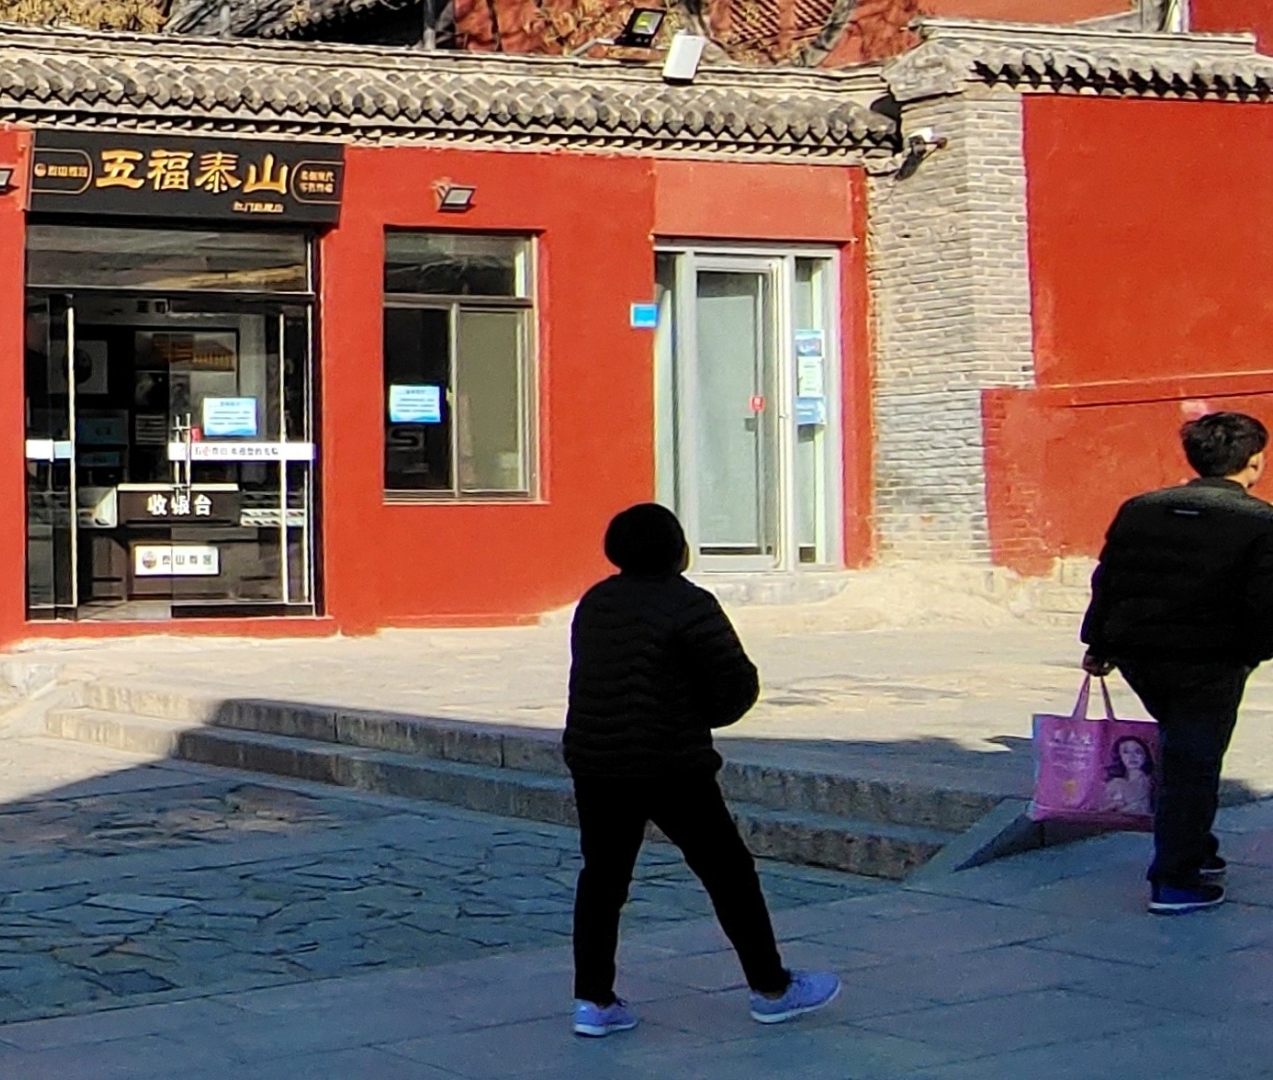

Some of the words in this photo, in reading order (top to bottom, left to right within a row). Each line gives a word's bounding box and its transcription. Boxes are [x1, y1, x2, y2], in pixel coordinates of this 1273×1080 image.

[96, 150, 289, 194] 五福泰山
[147, 494, 213, 516] 收银台
